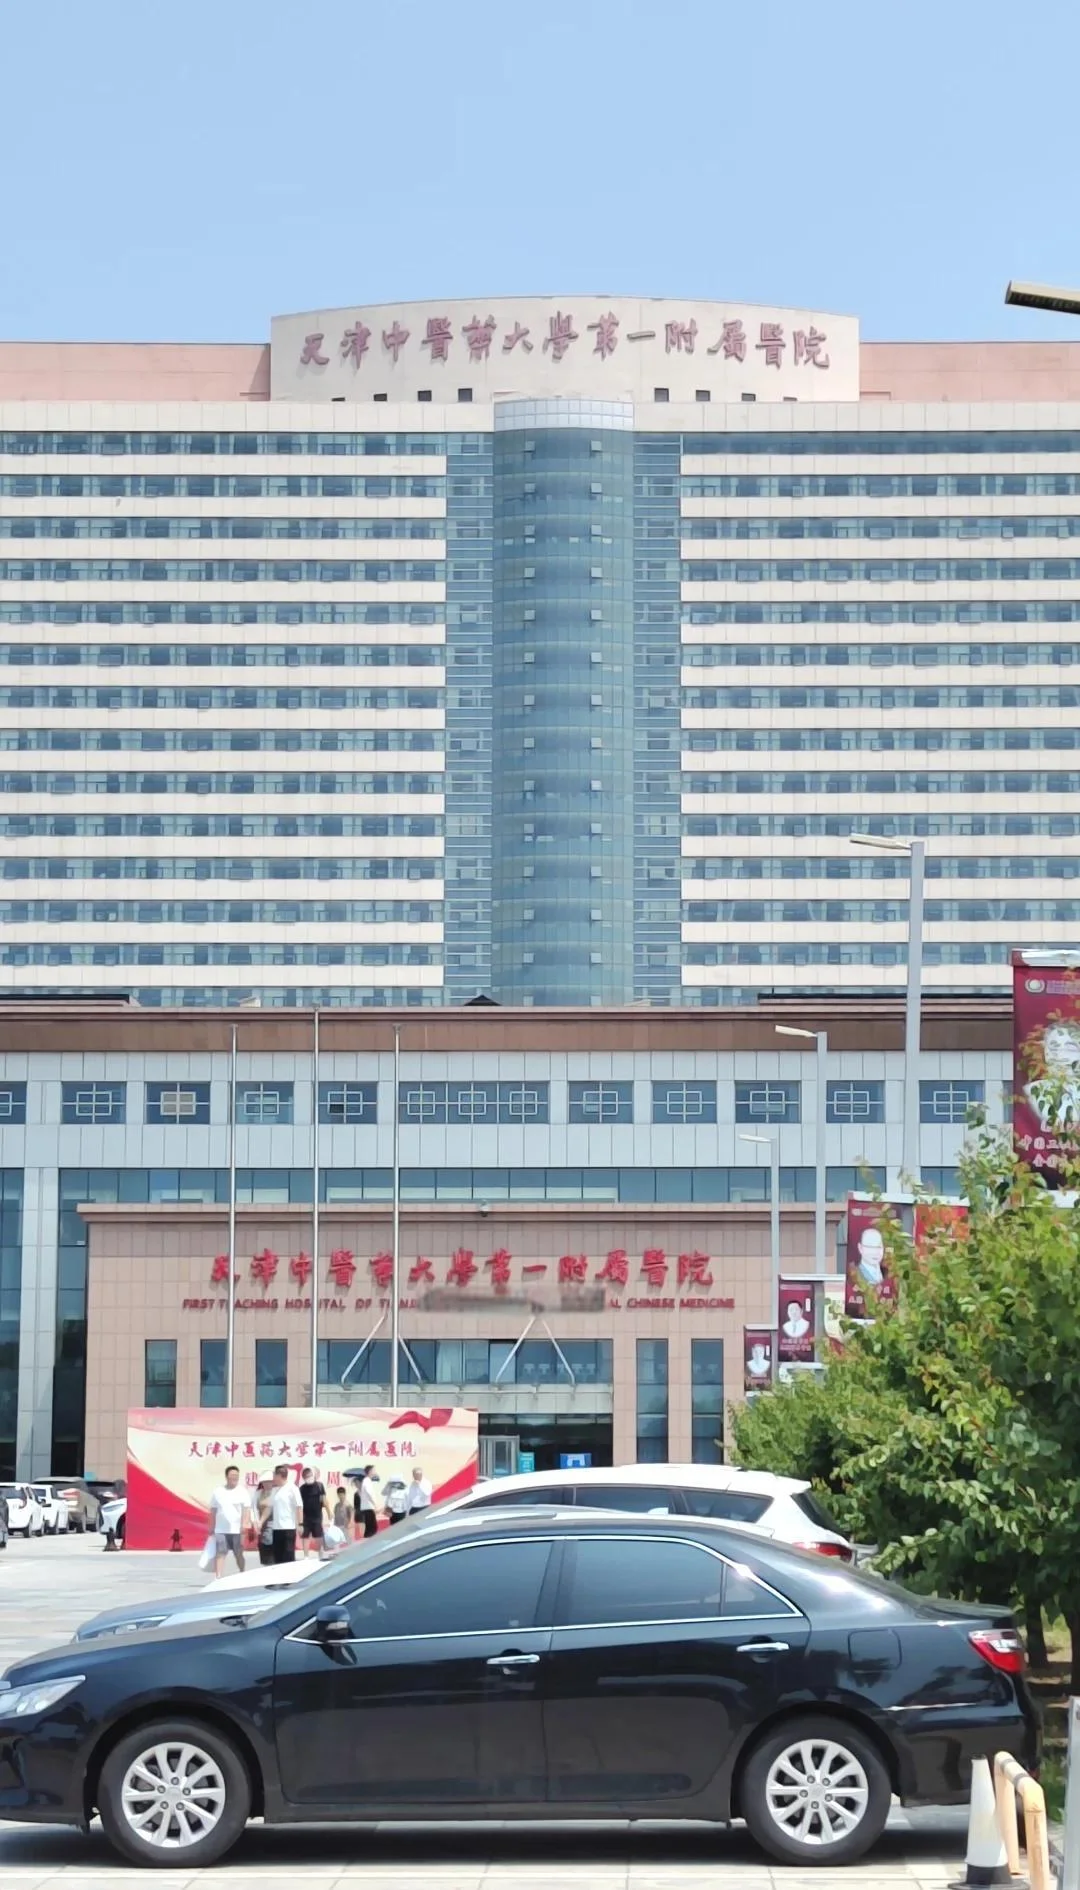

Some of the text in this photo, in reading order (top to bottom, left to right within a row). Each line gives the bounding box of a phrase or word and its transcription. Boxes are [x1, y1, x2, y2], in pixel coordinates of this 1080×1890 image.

[183, 1298, 215, 1309] FIRST
[219, 1298, 278, 1309] TACHING
[285, 1298, 345, 1309] HOSITAL
[355, 1298, 372, 1309] OF
[379, 1298, 418, 1309] TINJ
[627, 1298, 675, 1309] CHINESE
[679, 1298, 735, 1309] MEDICINE
[189, 1441, 417, 1458] 天津中医药大学第一附属医院
